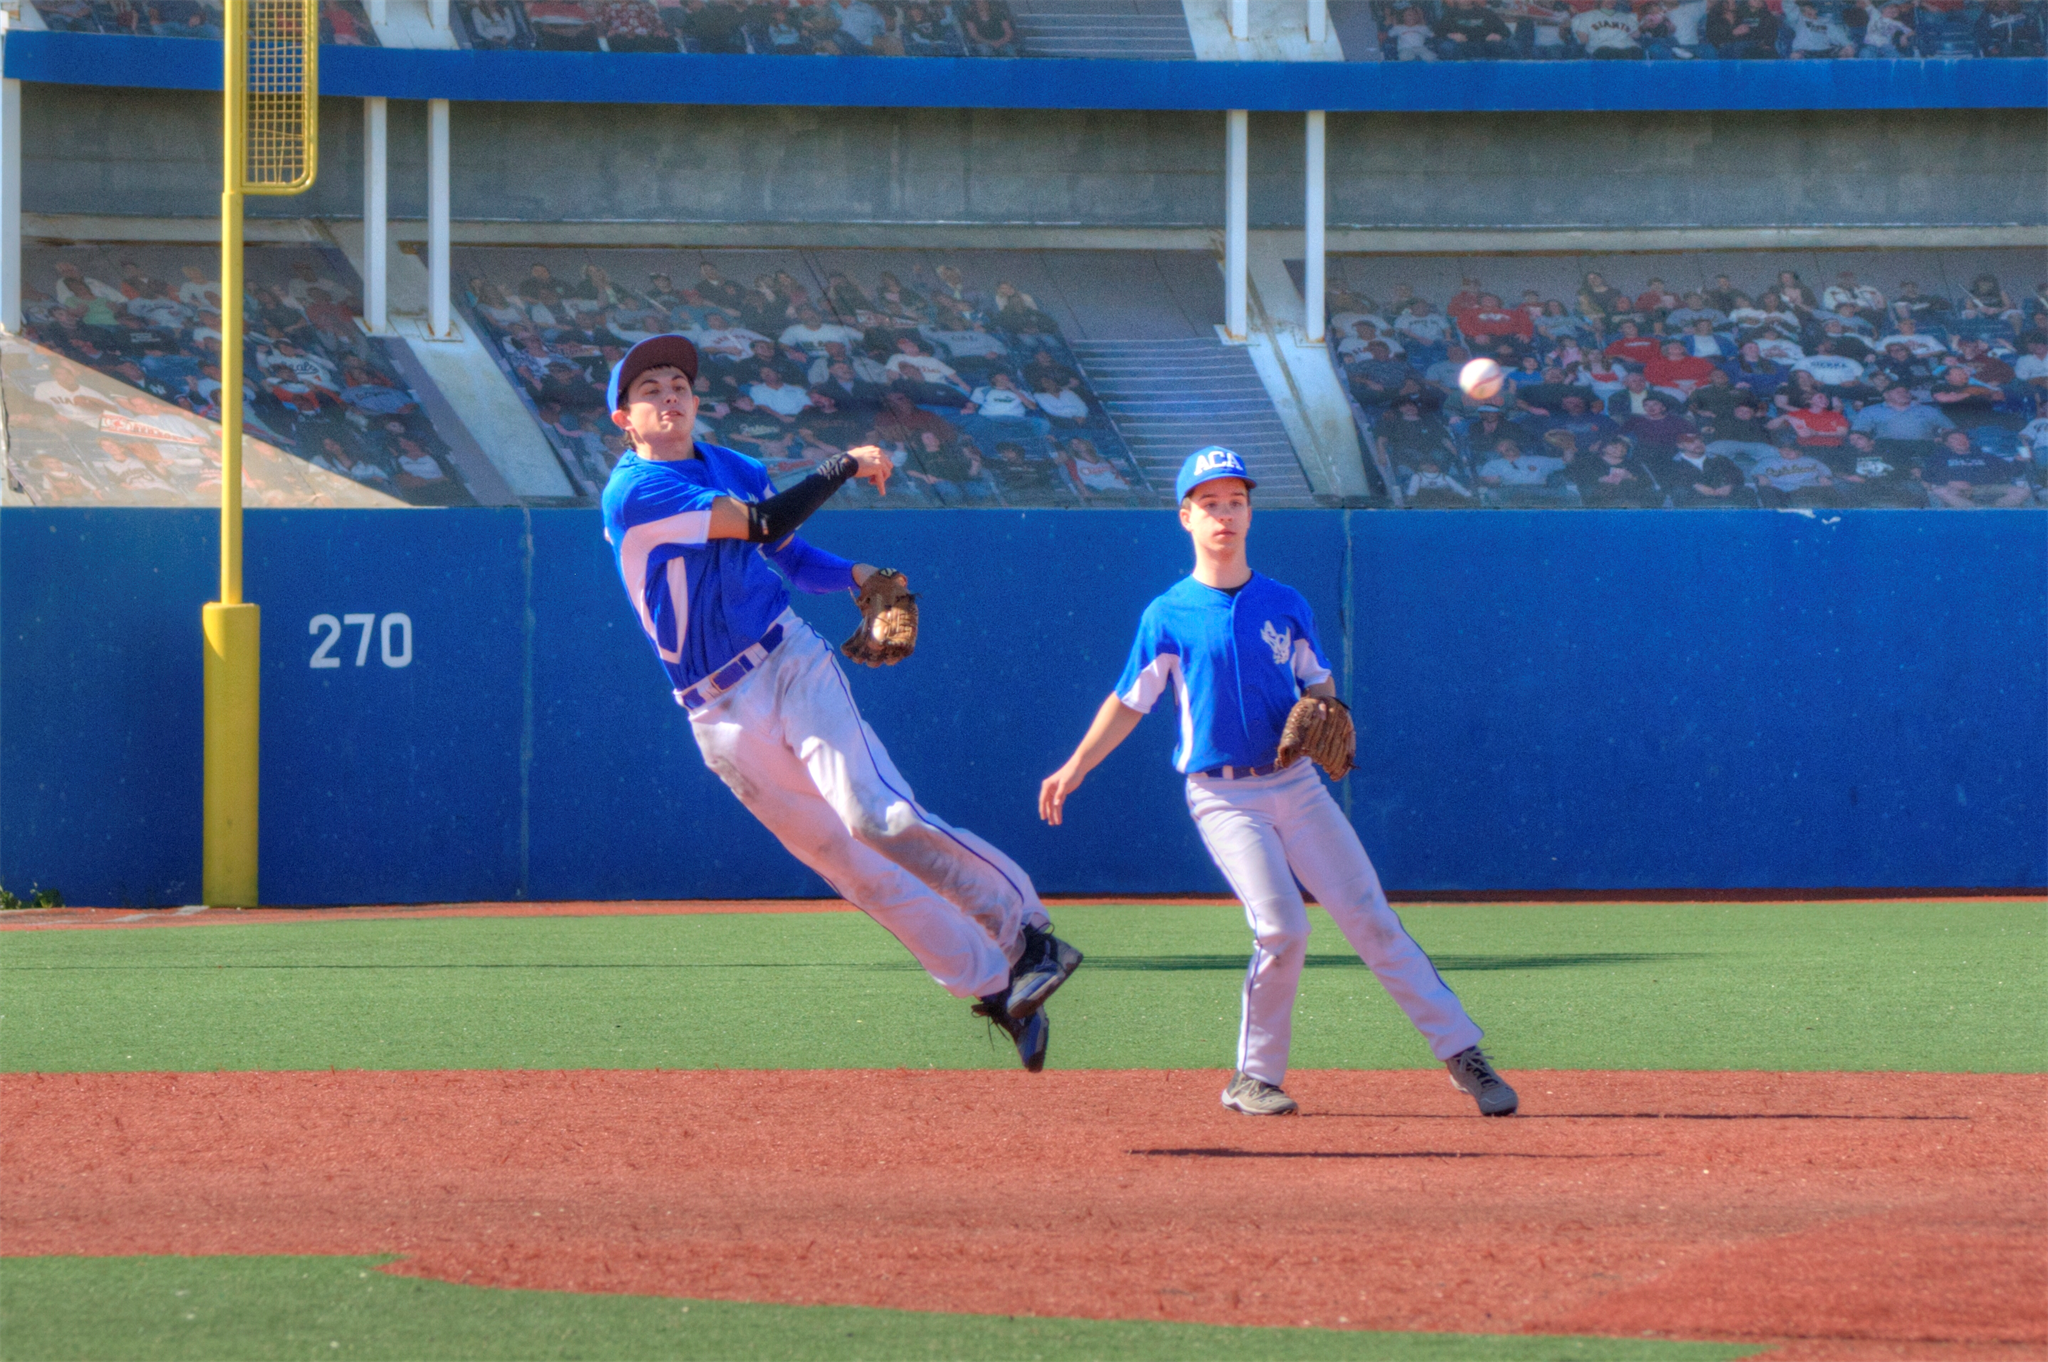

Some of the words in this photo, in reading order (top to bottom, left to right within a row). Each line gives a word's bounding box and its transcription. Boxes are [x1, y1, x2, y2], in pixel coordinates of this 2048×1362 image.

[1591, 20, 1632, 33] GIANTS
[1194, 451, 1243, 476] ACA
[309, 612, 412, 668] 270
